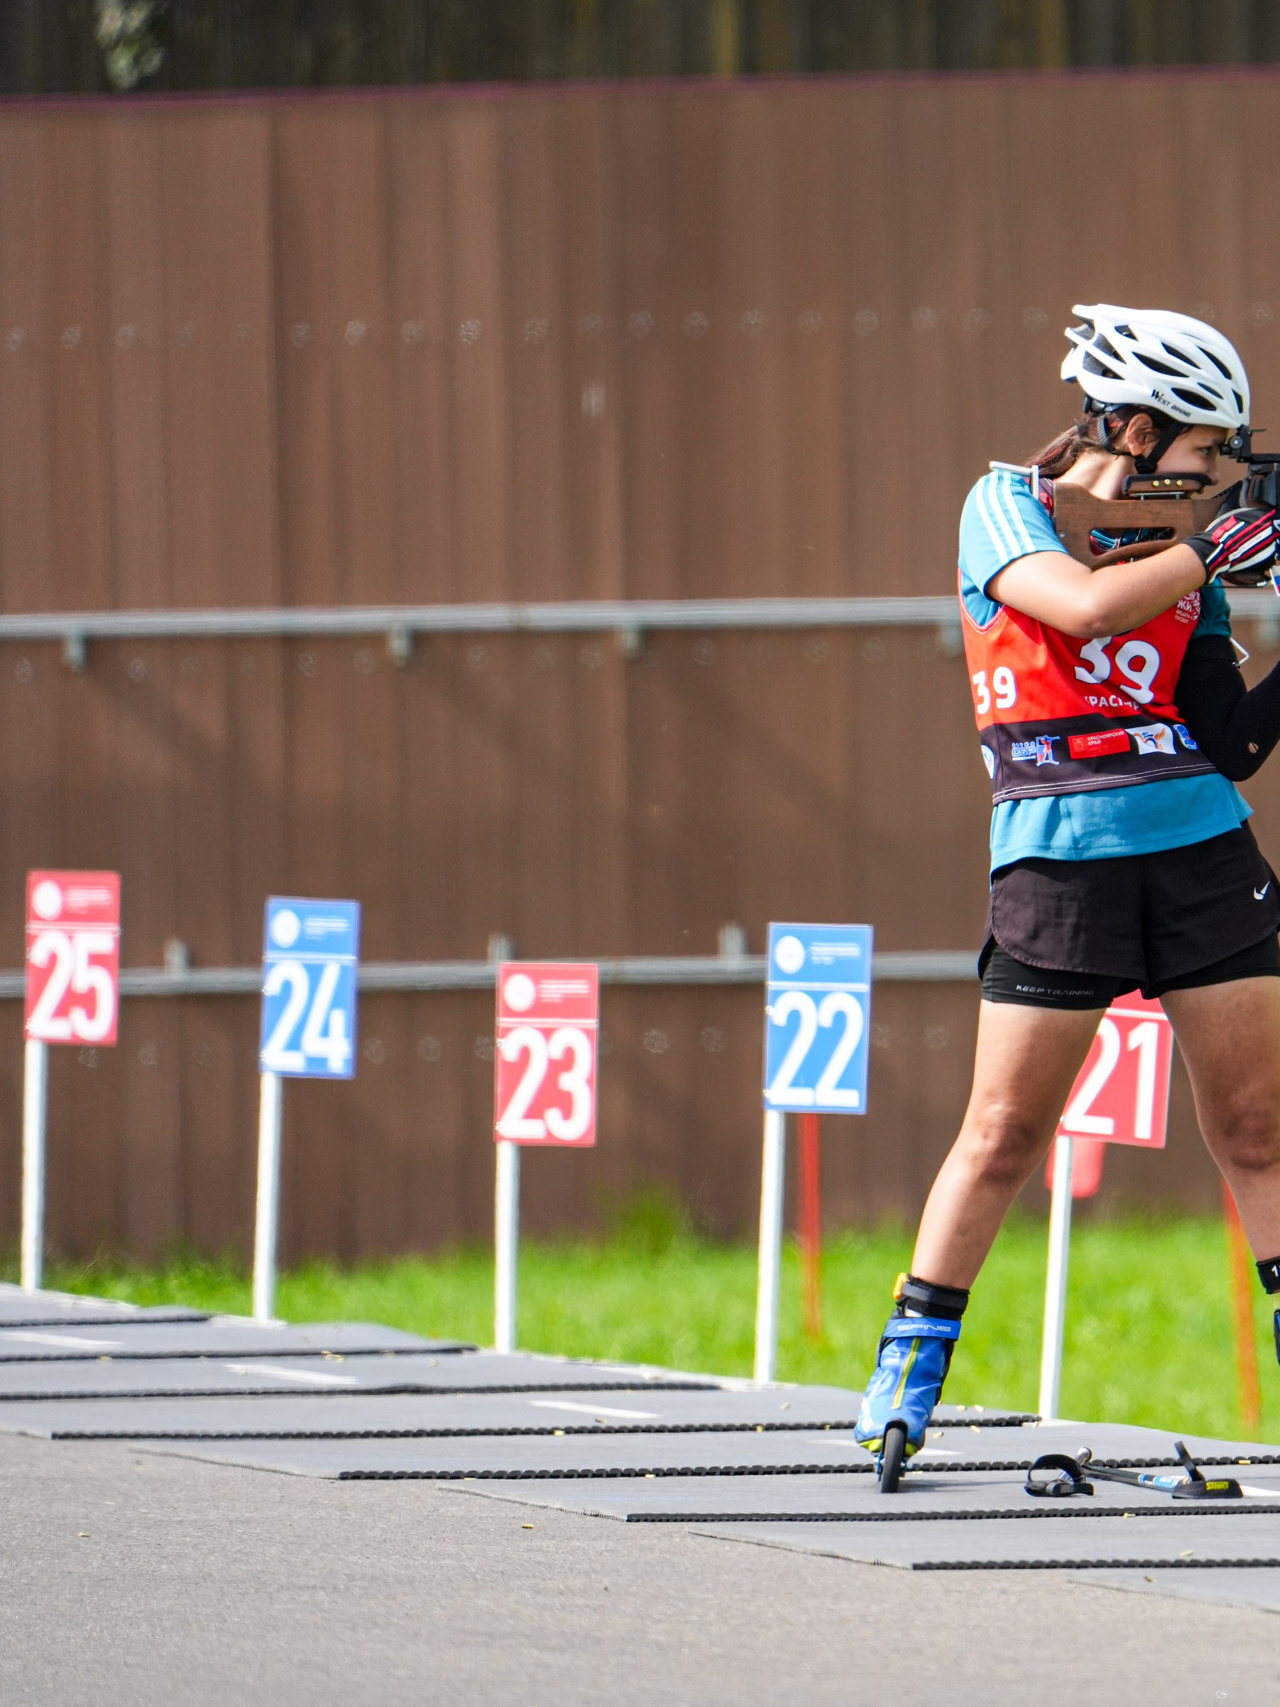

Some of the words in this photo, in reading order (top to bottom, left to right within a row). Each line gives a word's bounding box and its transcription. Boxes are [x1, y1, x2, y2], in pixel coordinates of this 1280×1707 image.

[972, 666, 1017, 715] 39
[1074, 636, 1160, 704] 39
[1087, 730, 1125, 741] КРАСНОЯРСКИЙ
[29, 931, 115, 1041] 25
[265, 961, 351, 1073] 24
[1016, 984, 1045, 993] KEEP
[500, 1027, 591, 1140] 23
[769, 991, 863, 1107] 22
[1064, 1017, 1159, 1139] 21
[897, 1323, 952, 1332] SPINE
